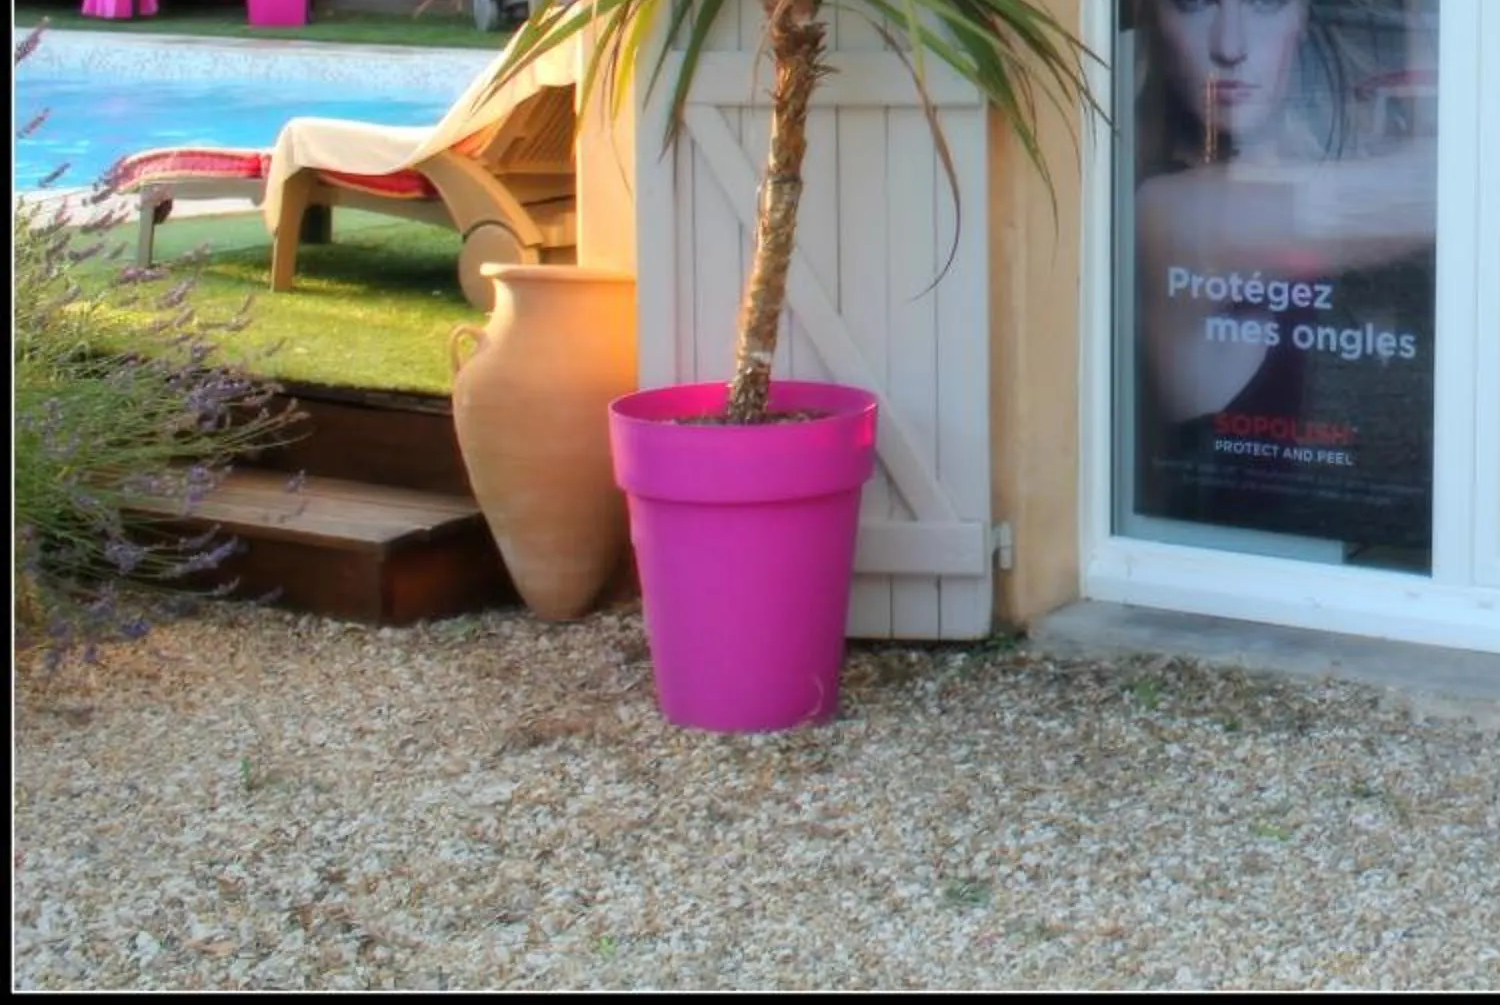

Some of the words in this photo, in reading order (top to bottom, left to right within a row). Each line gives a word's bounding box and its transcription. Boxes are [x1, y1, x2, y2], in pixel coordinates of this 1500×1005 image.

[1167, 266, 1334, 312] Protégez
[1205, 315, 1280, 346] mes
[1292, 322, 1417, 359] ongles
[1214, 413, 1353, 445] SOPOLISH
[1215, 439, 1279, 458] PROTECT
[1282, 447, 1314, 463] AND
[1317, 449, 1354, 466] PEEL
